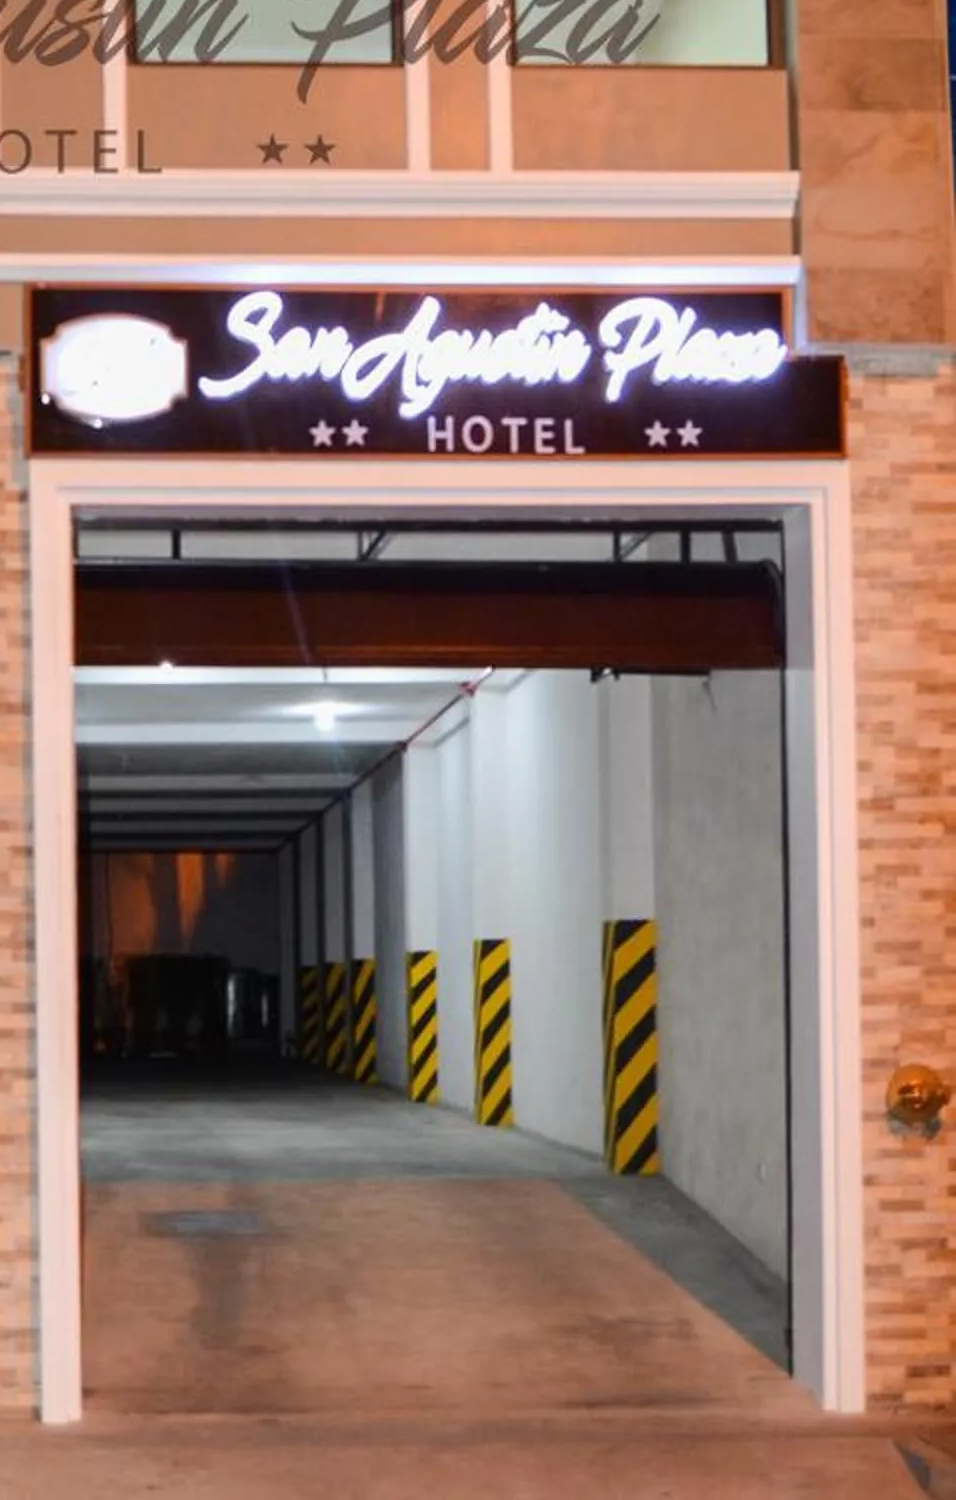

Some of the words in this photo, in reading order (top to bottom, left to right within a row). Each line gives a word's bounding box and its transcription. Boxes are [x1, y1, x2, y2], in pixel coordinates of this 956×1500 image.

[198, 291, 353, 399] San
[599, 297, 788, 402] Plaza
[427, 415, 586, 455] HOTEL
